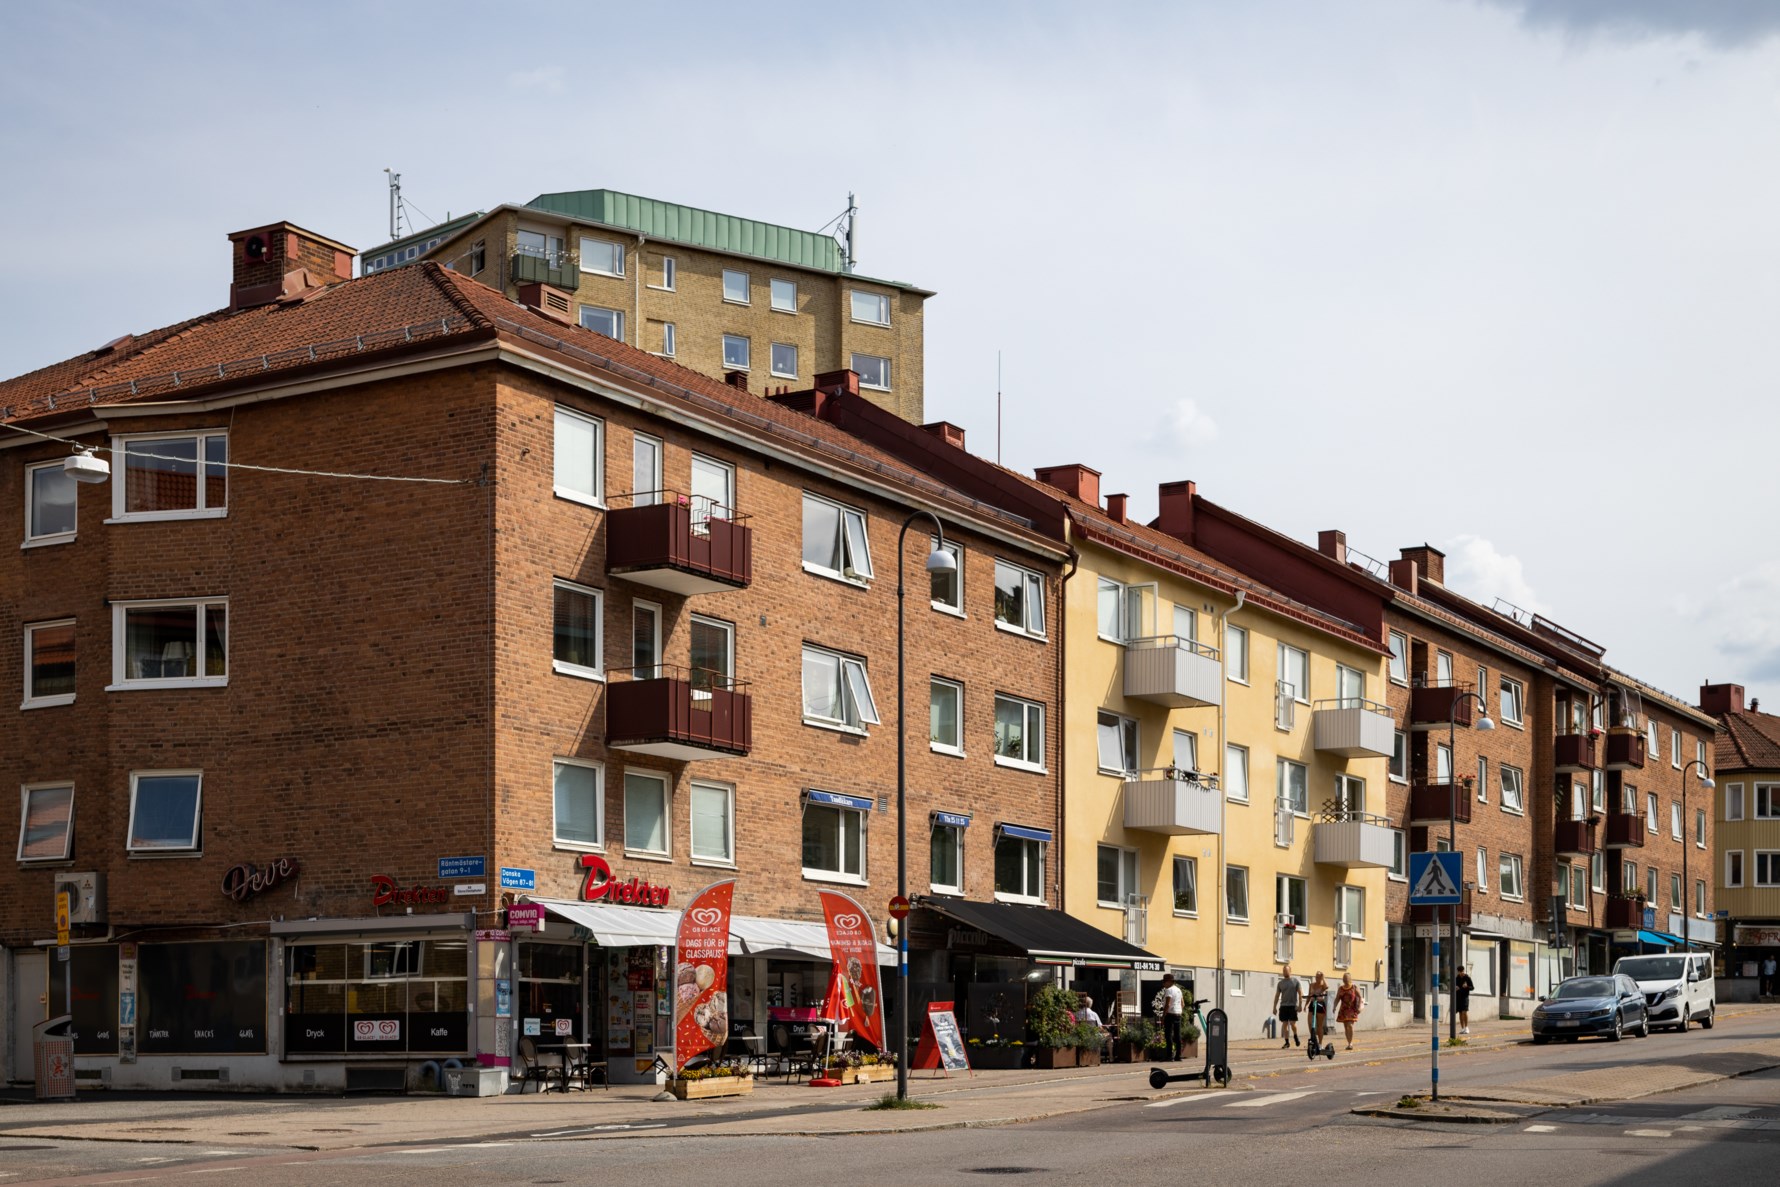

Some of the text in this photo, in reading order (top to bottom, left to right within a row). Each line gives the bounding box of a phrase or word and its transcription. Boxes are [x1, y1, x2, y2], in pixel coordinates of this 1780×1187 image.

[440, 858, 483, 868] Räntmästare-
[440, 868, 458, 876] gatan
[502, 869, 521, 877] Danska
[502, 877, 519, 886] Vägen
[582, 854, 670, 906] Direkten
[371, 874, 449, 906] Direkten
[509, 909, 538, 919] COMVIQ
[946, 924, 989, 950] piccolo
[685, 937, 725, 948] DAGS FÖR EN
[1072, 957, 1086, 967] piccolo
[193, 1029, 214, 1039] SNACKS
[238, 1029, 254, 1039] GLASS
[305, 1028, 325, 1040] Dryck
[430, 1027, 449, 1037] Kaffe
